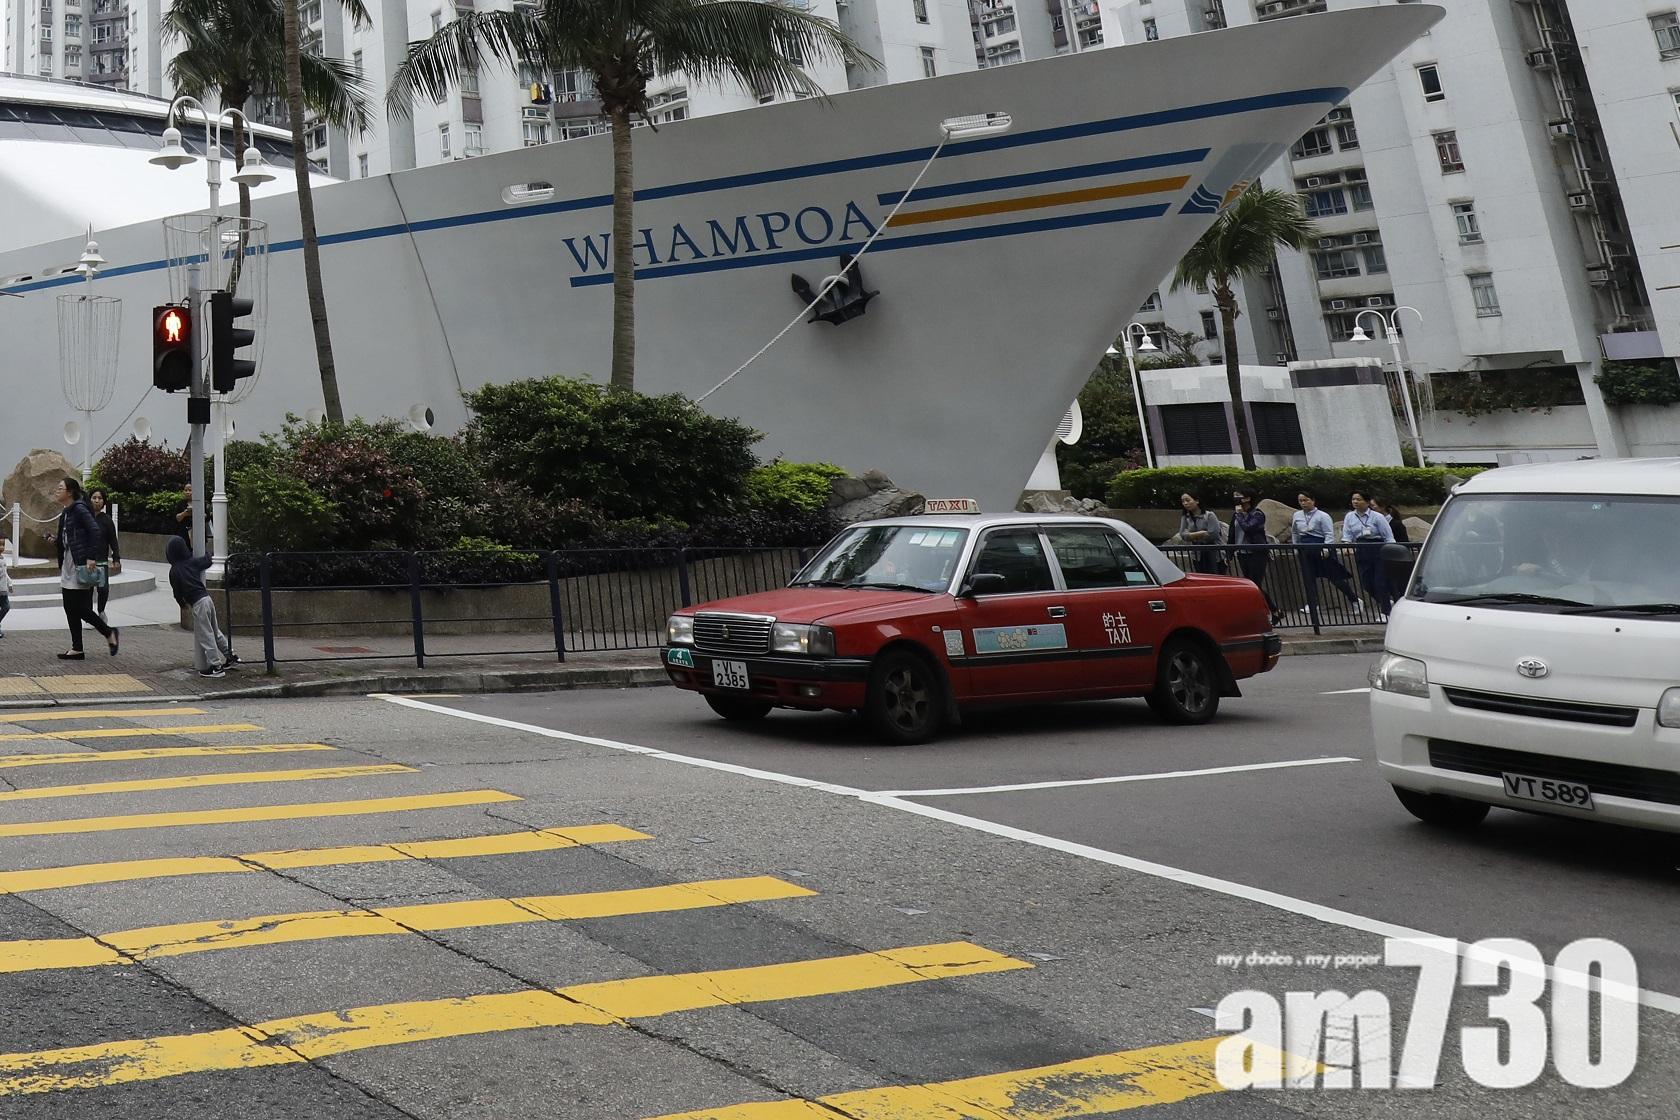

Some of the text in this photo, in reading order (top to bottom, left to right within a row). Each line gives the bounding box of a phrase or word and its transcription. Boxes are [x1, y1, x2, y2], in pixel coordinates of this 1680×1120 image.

[562, 200, 884, 273] WHAMPOA
[927, 499, 969, 511] TAXI
[1102, 612, 1128, 628] 的士
[1105, 627, 1132, 645] TAXI
[676, 650, 683, 660] 4
[722, 661, 738, 674] VL
[716, 673, 746, 688] 2385
[1504, 774, 1590, 805] VT 589
